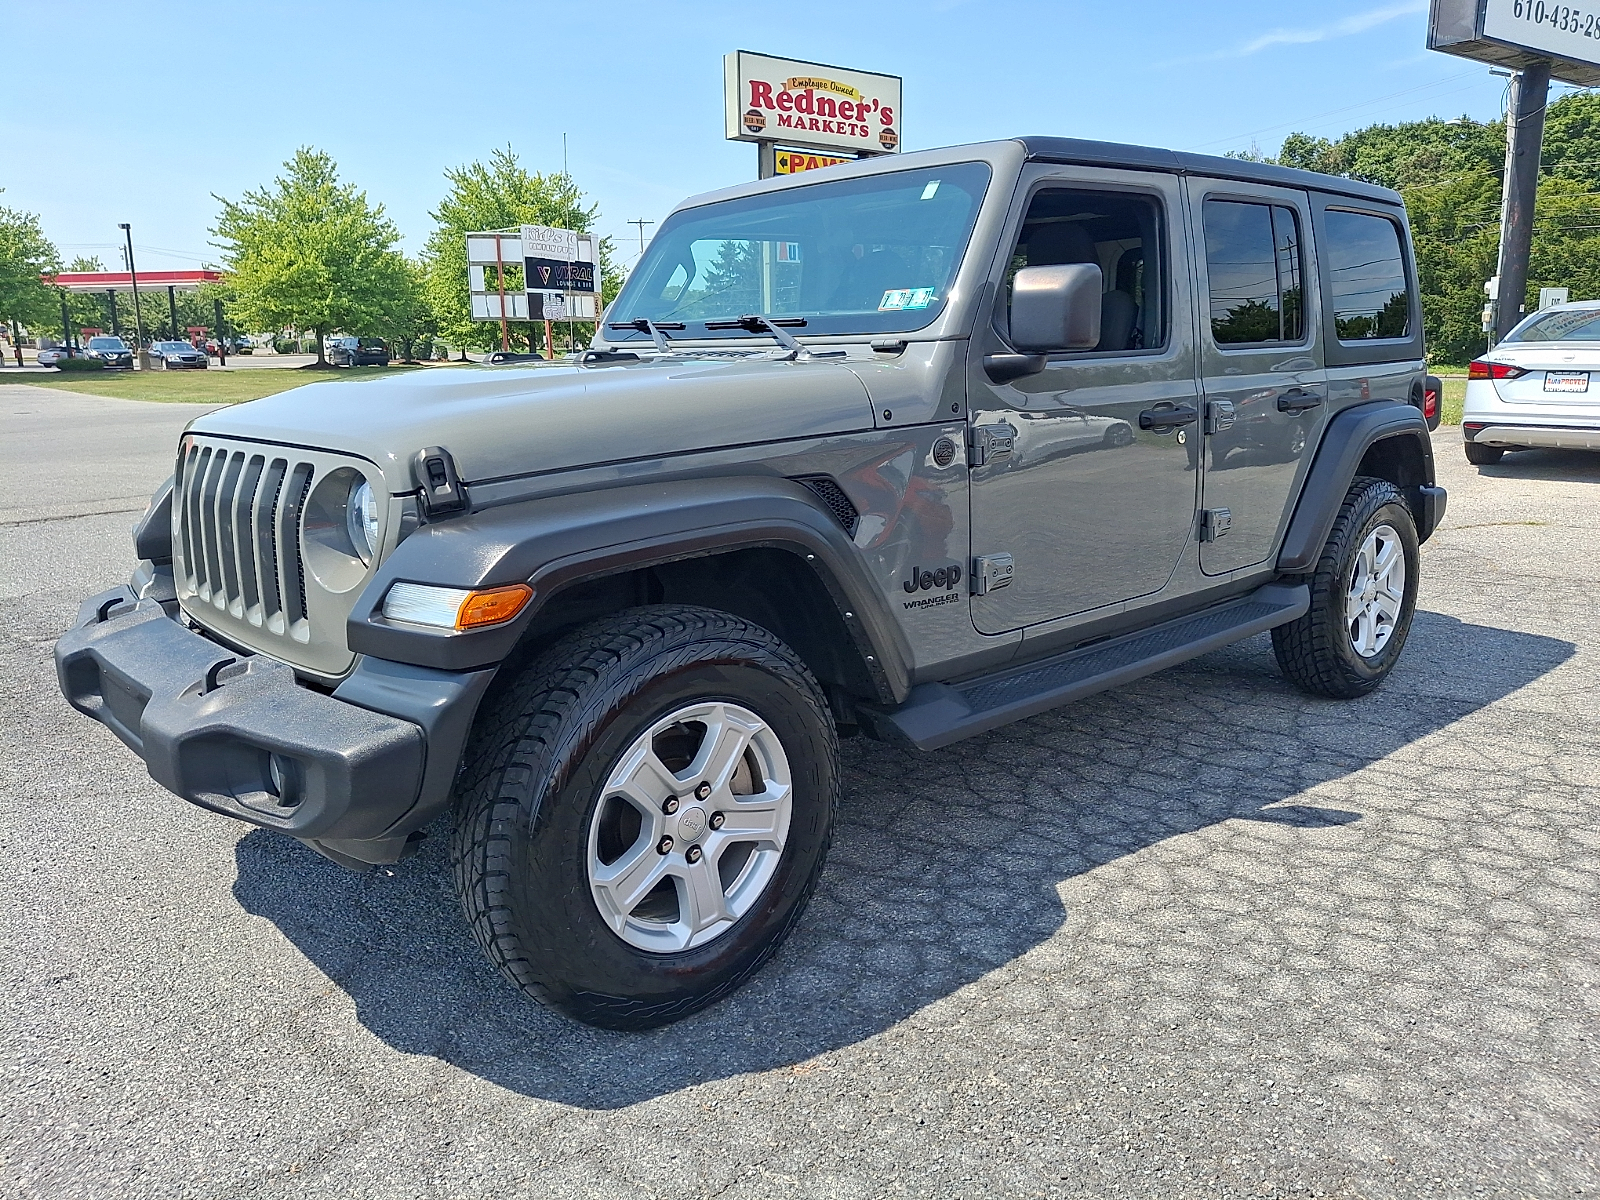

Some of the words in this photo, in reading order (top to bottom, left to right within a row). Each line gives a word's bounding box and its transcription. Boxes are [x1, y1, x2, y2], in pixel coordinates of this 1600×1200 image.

[792, 77, 828, 90] Employee
[830, 81, 855, 96] Owned
[749, 80, 893, 126] Redner's
[777, 113, 869, 137] MARKETS
[524, 227, 563, 243] Kid's
[903, 565, 962, 594] Jeep
[903, 592, 960, 610] WRANGLER
[921, 598, 960, 610] UNLIMITED
